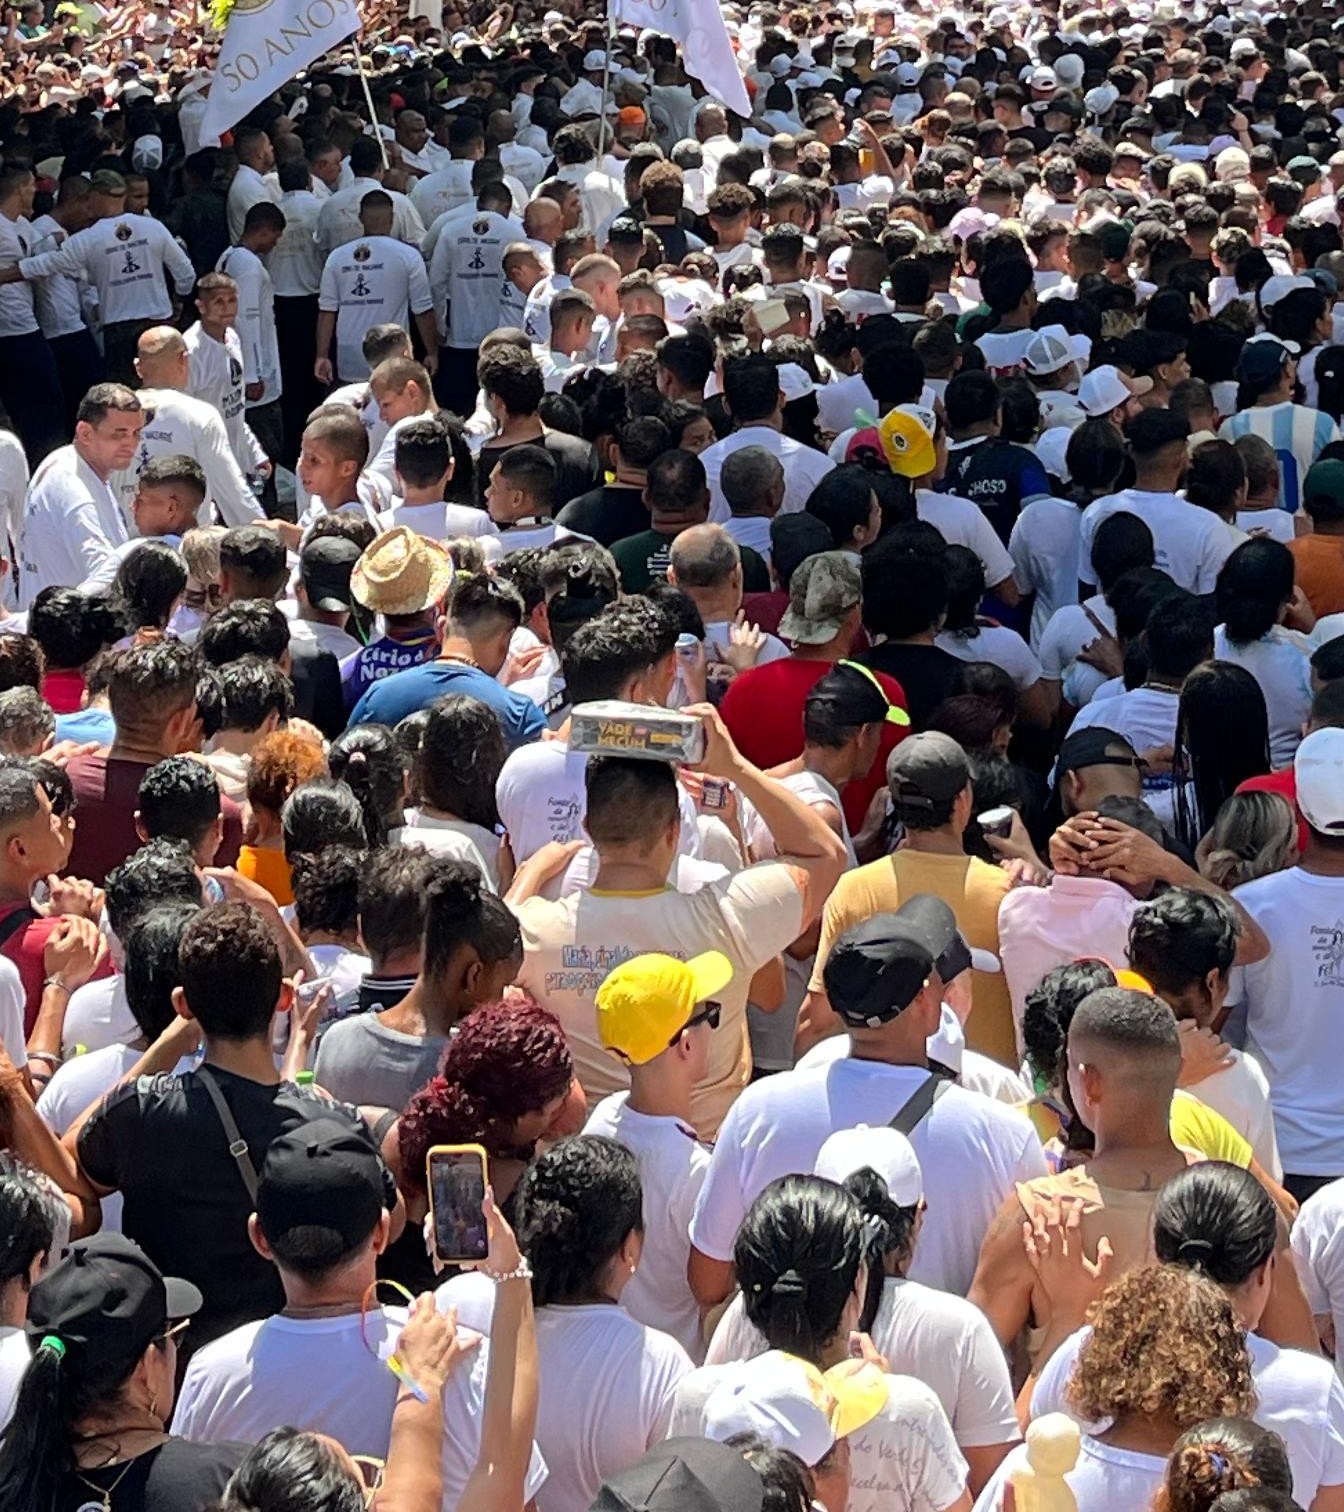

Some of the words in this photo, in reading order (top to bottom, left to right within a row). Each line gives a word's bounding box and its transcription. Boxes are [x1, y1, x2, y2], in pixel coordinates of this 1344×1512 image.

[220, 53, 260, 93] 50
[599, 721, 633, 737] VADE
[597, 736, 646, 749] MECUM
